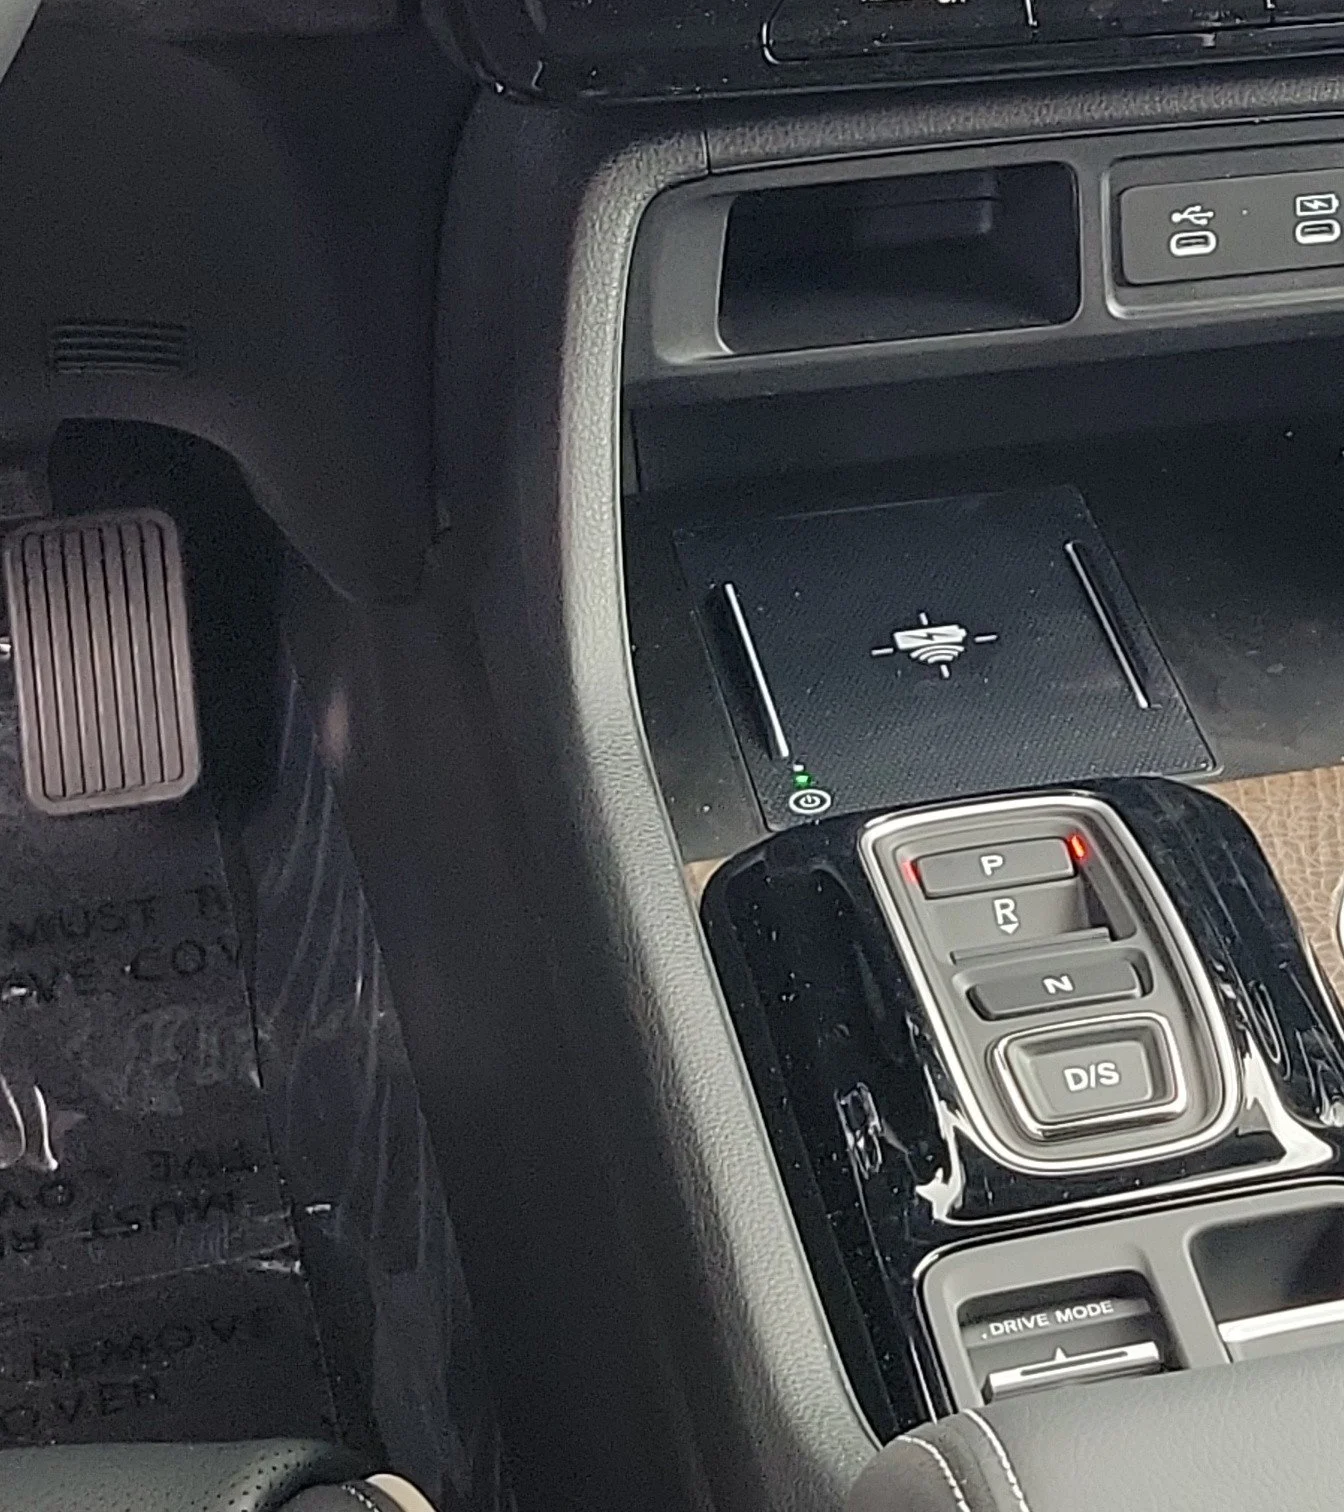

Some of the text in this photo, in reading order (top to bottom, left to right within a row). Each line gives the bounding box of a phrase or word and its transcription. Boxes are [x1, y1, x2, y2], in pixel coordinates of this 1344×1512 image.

[980, 855, 1004, 876] P
[993, 898, 1018, 924] R
[1043, 974, 1073, 994] N
[1064, 1061, 1120, 1091] D/S
[989, 1300, 1115, 1336] DRIVE MODE
